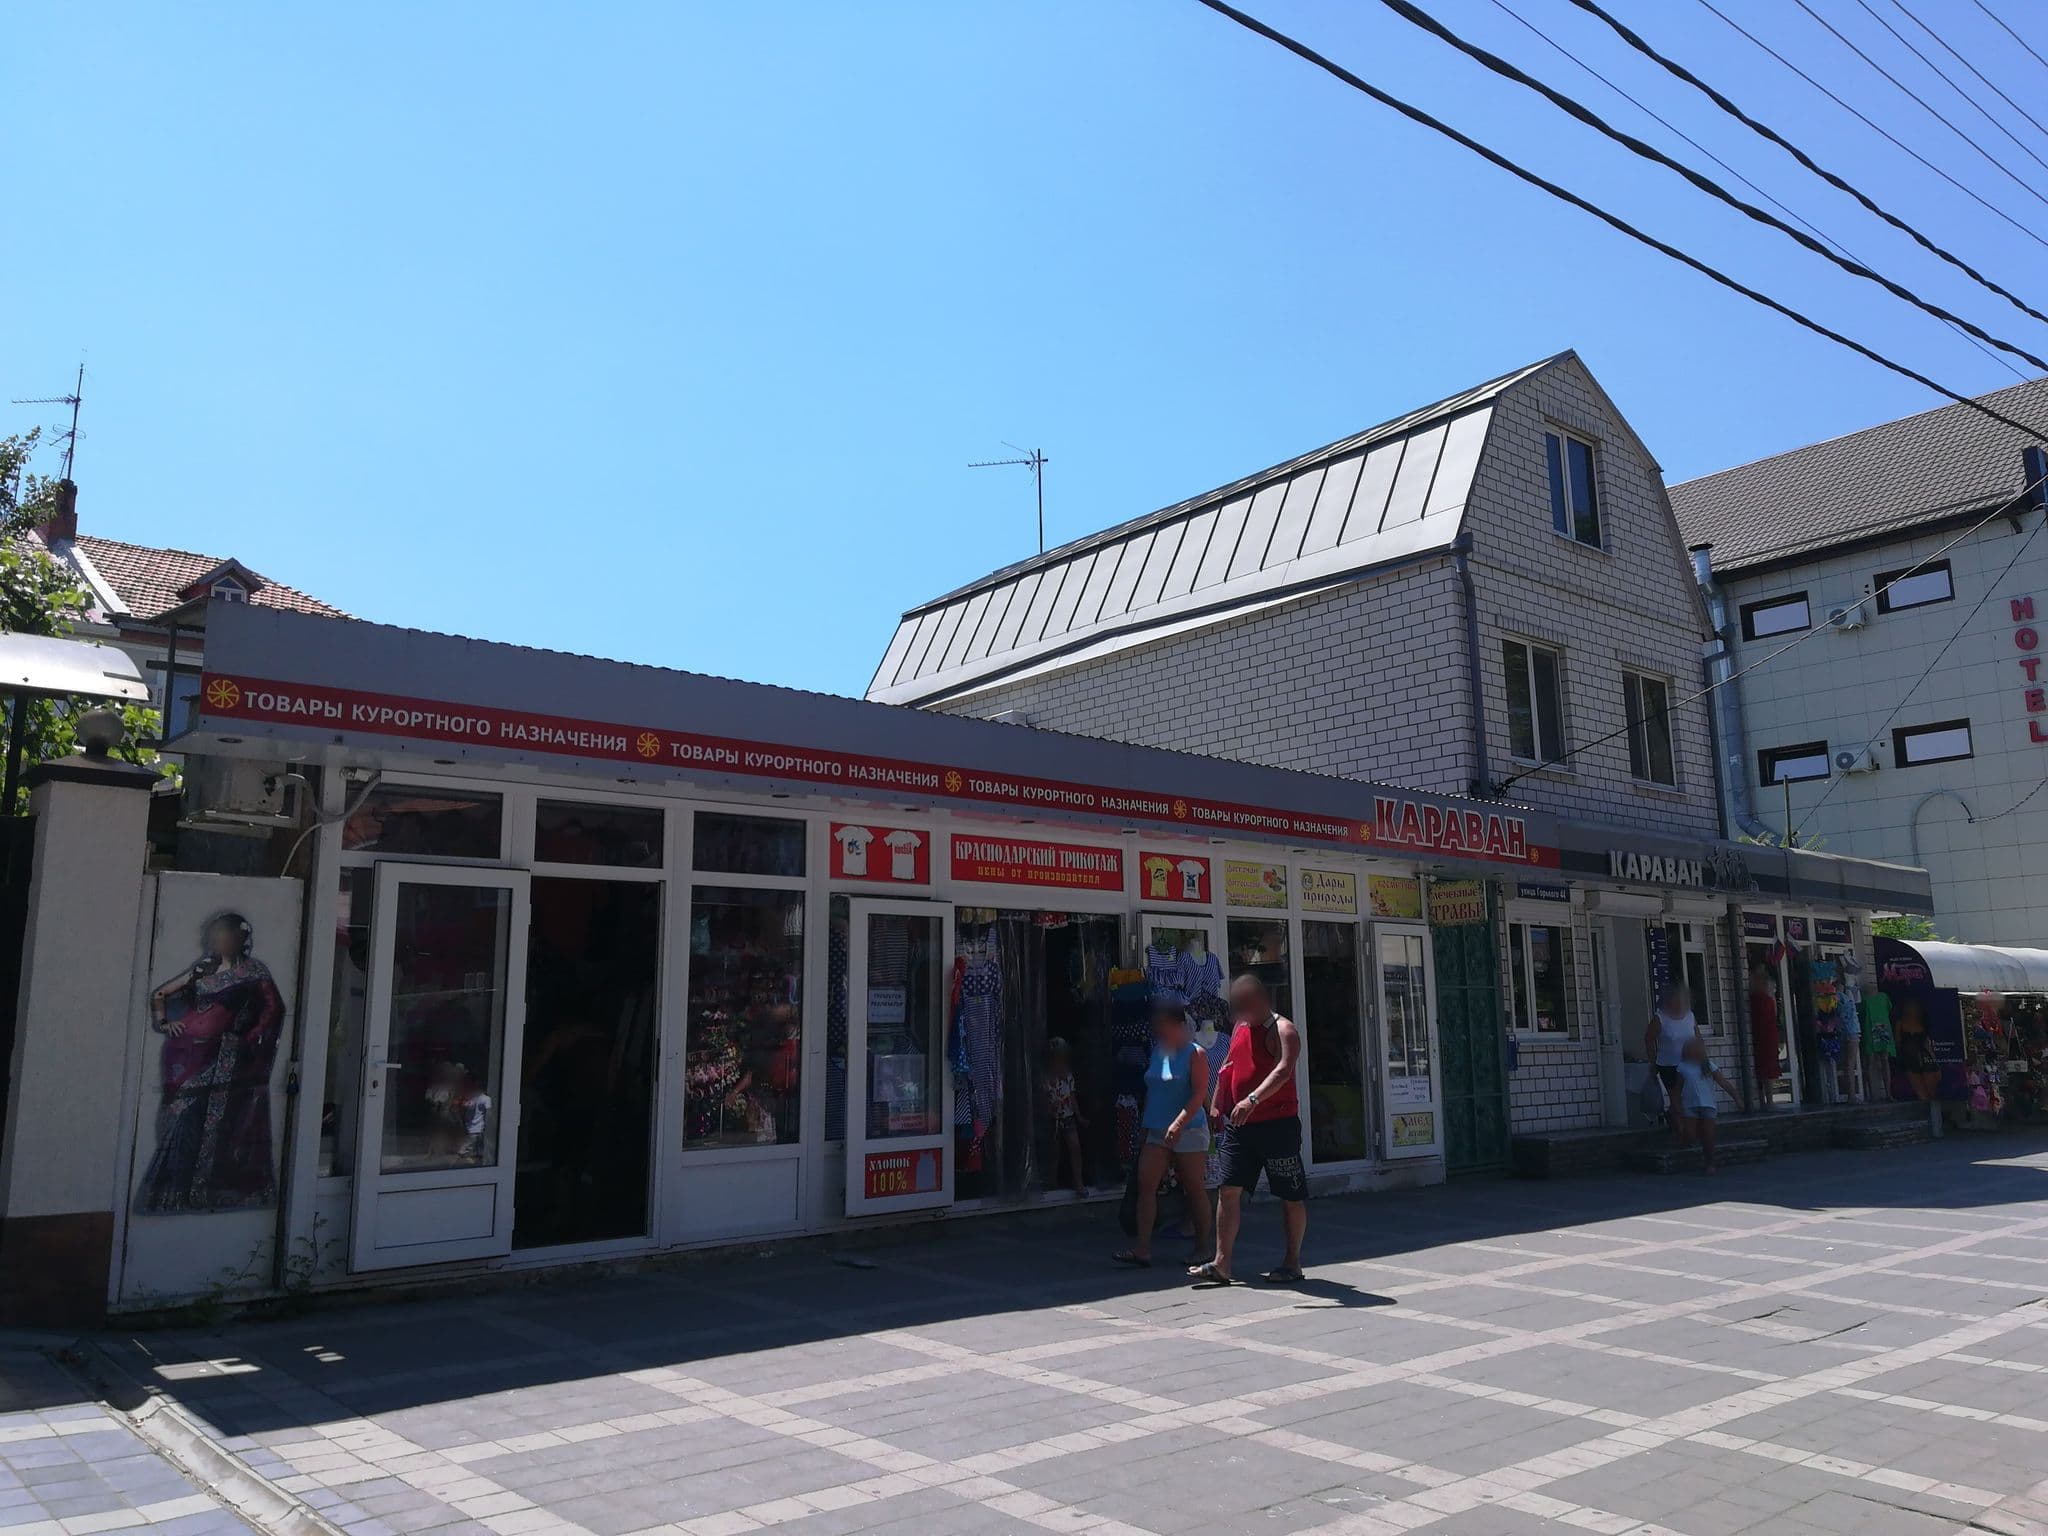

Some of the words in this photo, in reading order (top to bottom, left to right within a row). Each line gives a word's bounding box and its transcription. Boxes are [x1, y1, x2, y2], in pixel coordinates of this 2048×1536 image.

[2010, 597, 2048, 743] HOTEL
[244, 691, 343, 719] ТОВАРЫ
[351, 703, 491, 737] КУРОРТНОГО
[500, 721, 627, 753] НАЗНАЧЕНИЯ
[671, 742, 739, 765] ТОВАРЫ
[745, 751, 842, 777] КУРОРТНОГО
[849, 763, 939, 788] НАЗНАЧЕНИЯ
[969, 778, 1019, 797] ТОВАРЫ
[1023, 785, 1095, 807] КУРОРТНОГО
[1101, 796, 1169, 815] НАЗНАЧЕНИЯ
[1191, 806, 1231, 823] ТОВАРЫ
[1233, 811, 1289, 831] КУРОРТНОГО
[1293, 819, 1349, 837] НАЗНАЧЕНИЯ
[1373, 796, 1528, 860] КАРАВАН
[955, 840, 1056, 867] КРАСНОДАРСКИЙ
[1059, 850, 1118, 872] ТРИКОТАЖ
[1610, 849, 1704, 887] КАРАВАН
[978, 866, 1005, 877] ЦЕНЫ
[1011, 868, 1022, 878] ОТ
[1027, 870, 1100, 884] ПРОИЗВОДИТЕЛЯ
[1316, 874, 1346, 891] Дары
[1303, 891, 1353, 905] природы
[1431, 902, 1480, 920] ТРАВЫ
[869, 1157, 911, 1171] ХЛОПОК
[872, 1170, 907, 1193] 100%
